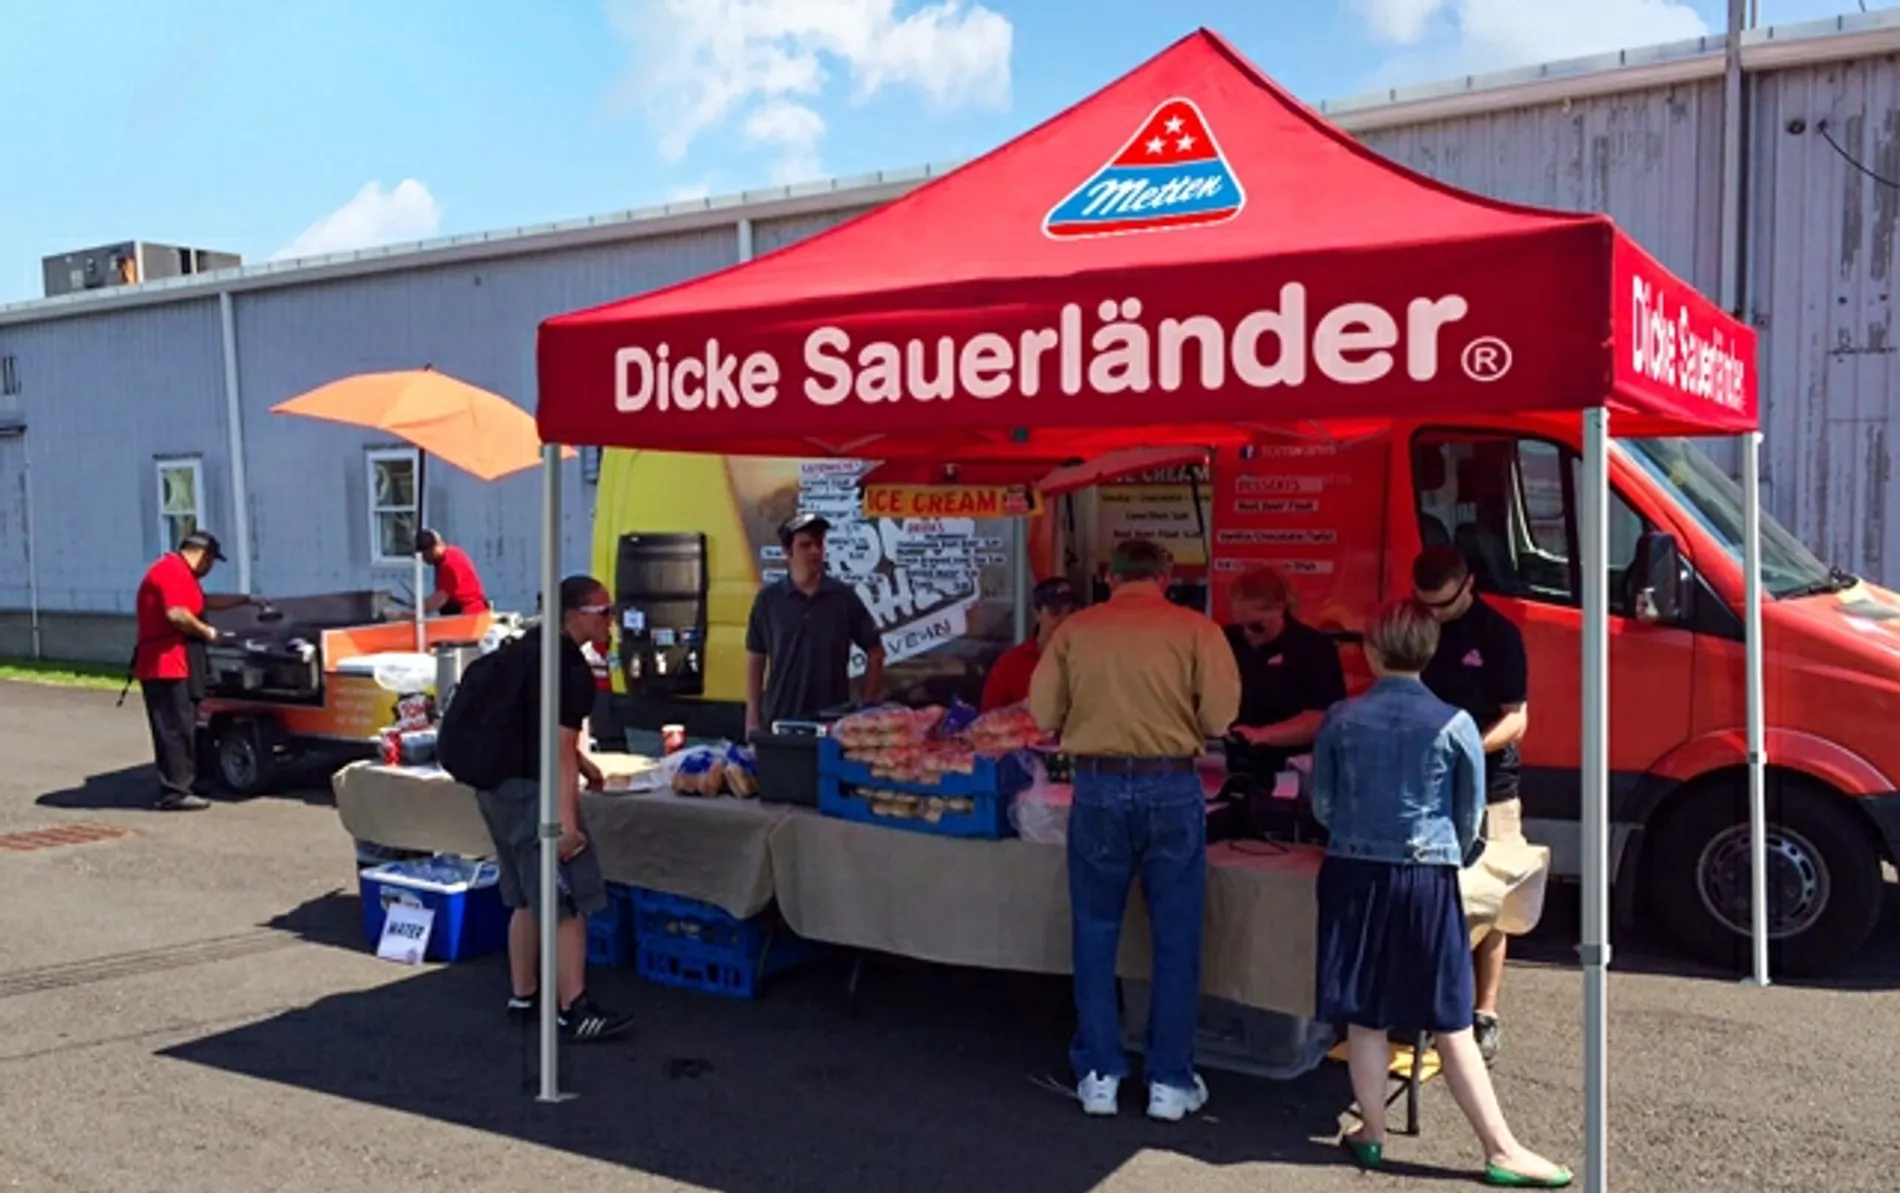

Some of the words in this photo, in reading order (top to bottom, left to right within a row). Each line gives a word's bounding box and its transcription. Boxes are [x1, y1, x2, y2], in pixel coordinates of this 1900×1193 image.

[1081, 174, 1224, 216] Metten
[614, 337, 781, 413] Dicke
[802, 281, 1468, 405] Sauerländer
[1632, 274, 1676, 388] Dicke
[867, 489, 904, 513] ICE
[912, 489, 997, 514] CREAM
[388, 922, 425, 939] WATER
